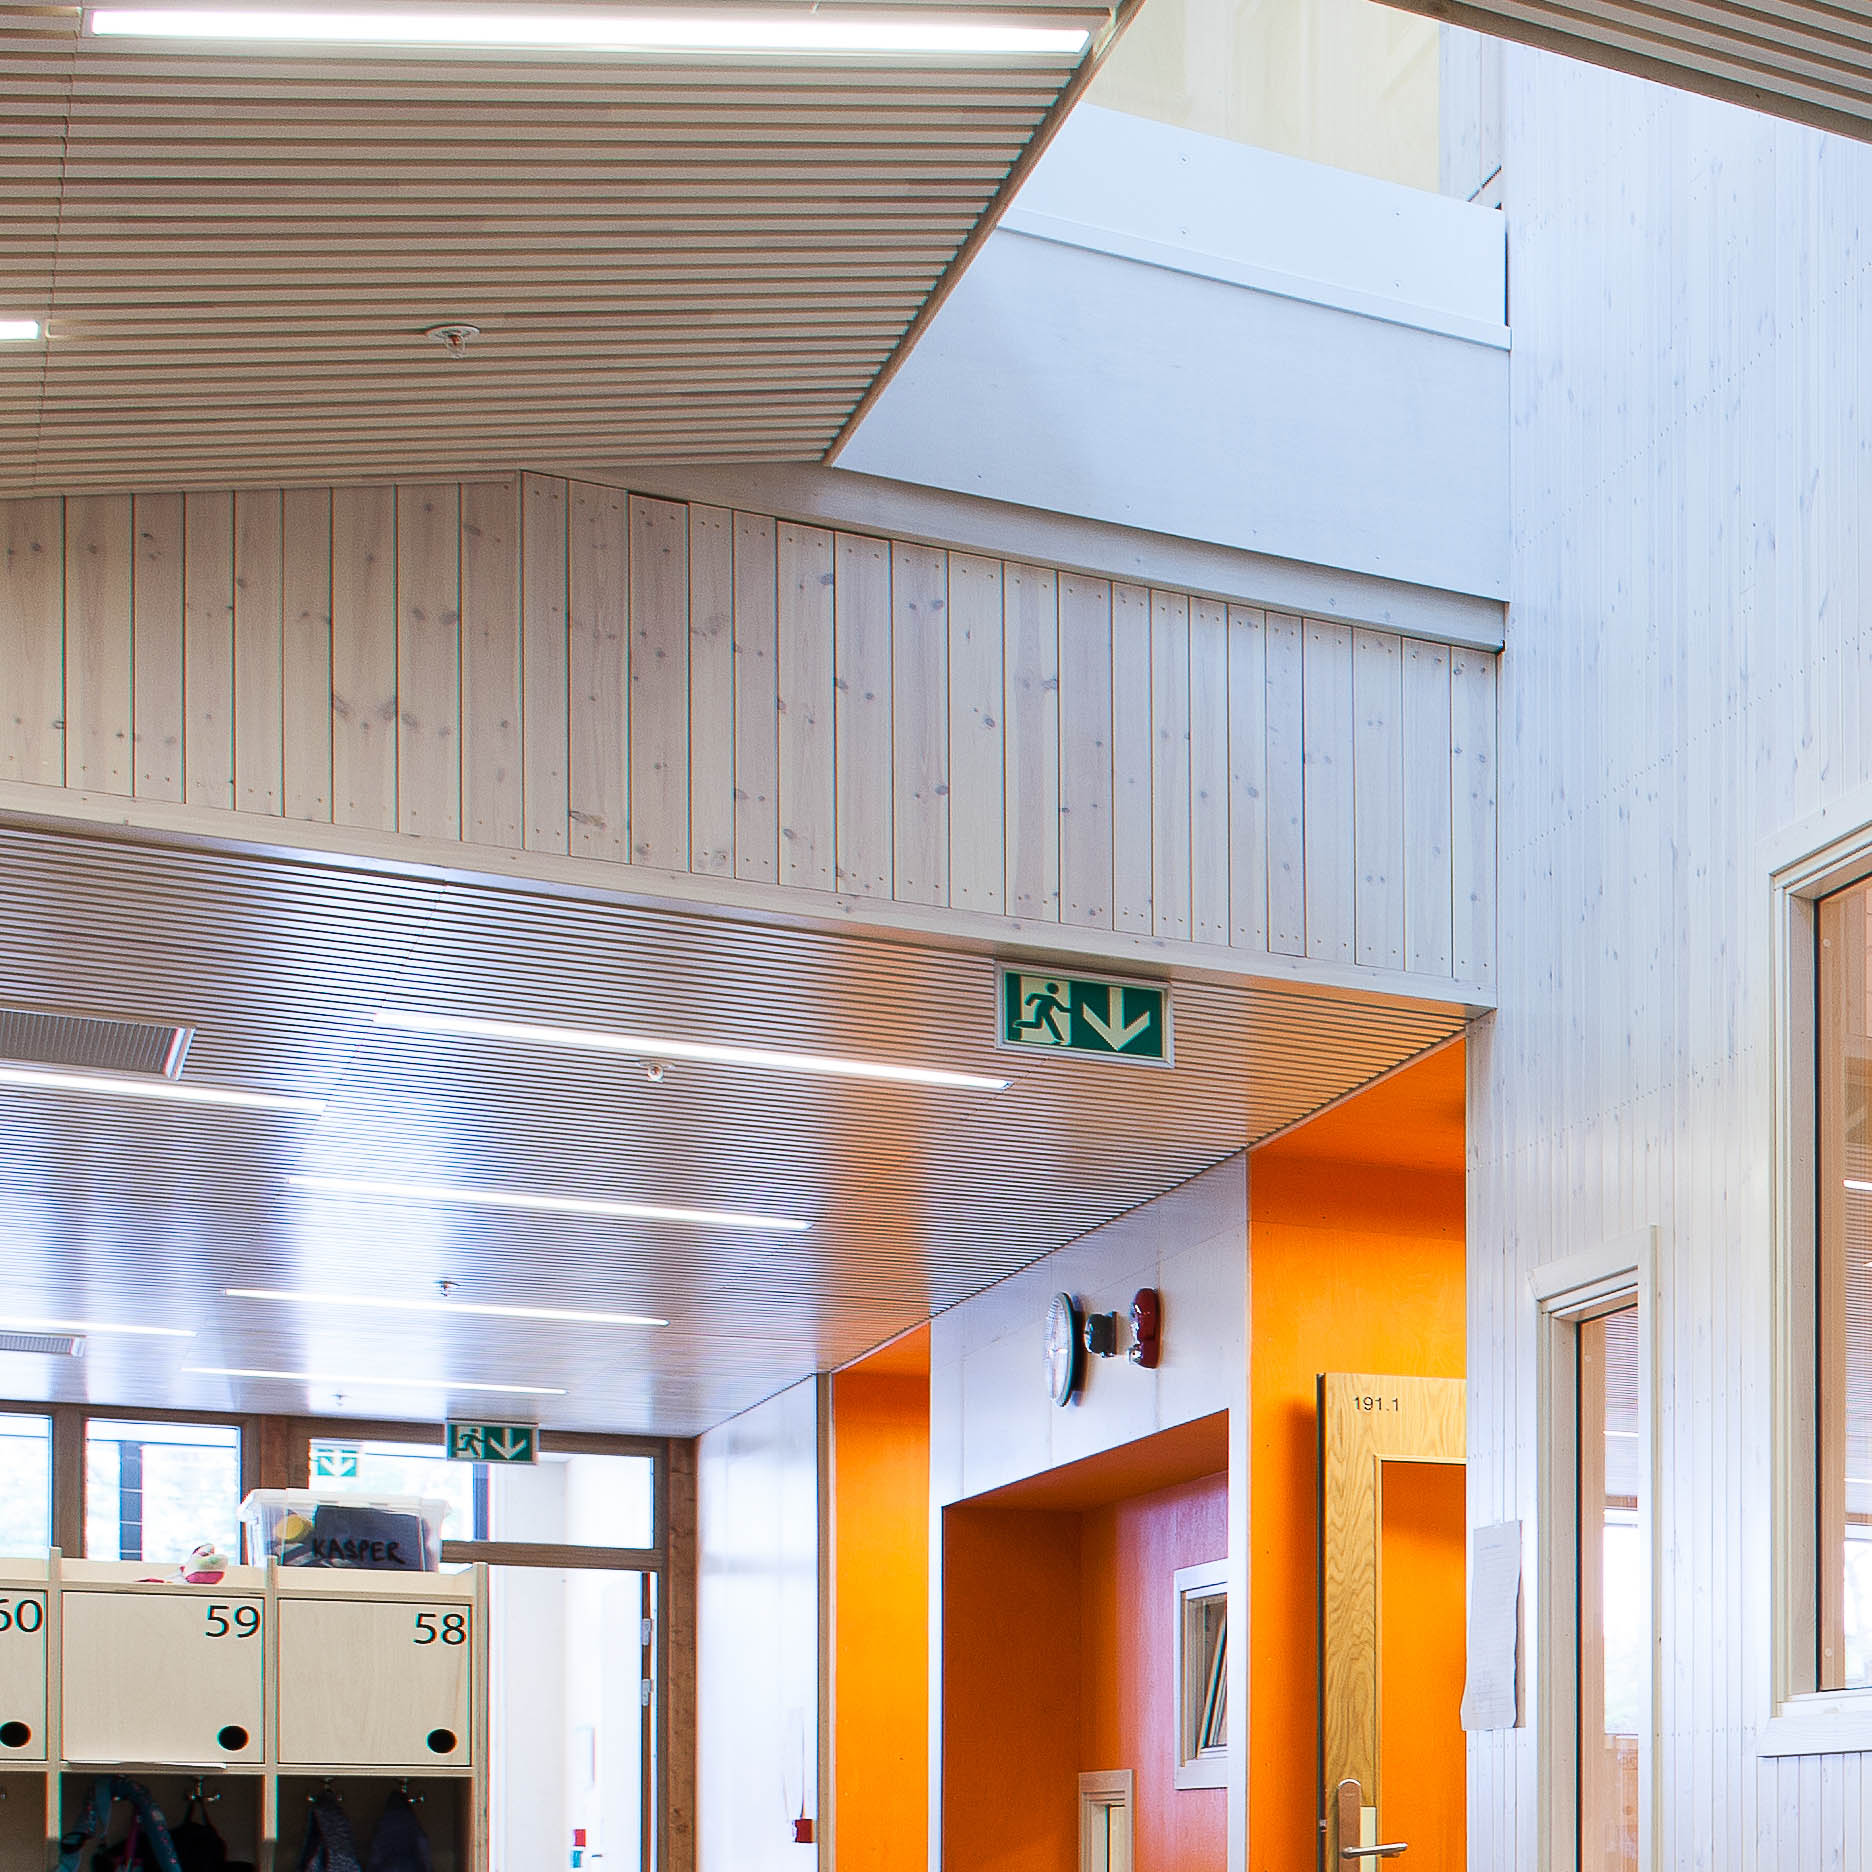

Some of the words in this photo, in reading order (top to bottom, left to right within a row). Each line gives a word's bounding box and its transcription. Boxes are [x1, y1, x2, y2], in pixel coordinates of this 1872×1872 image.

[1354, 1396, 1398, 1411] 191.1
[313, 1538, 406, 1565] KASPER
[205, 1604, 260, 1638] 59
[413, 1612, 466, 1645] 58
